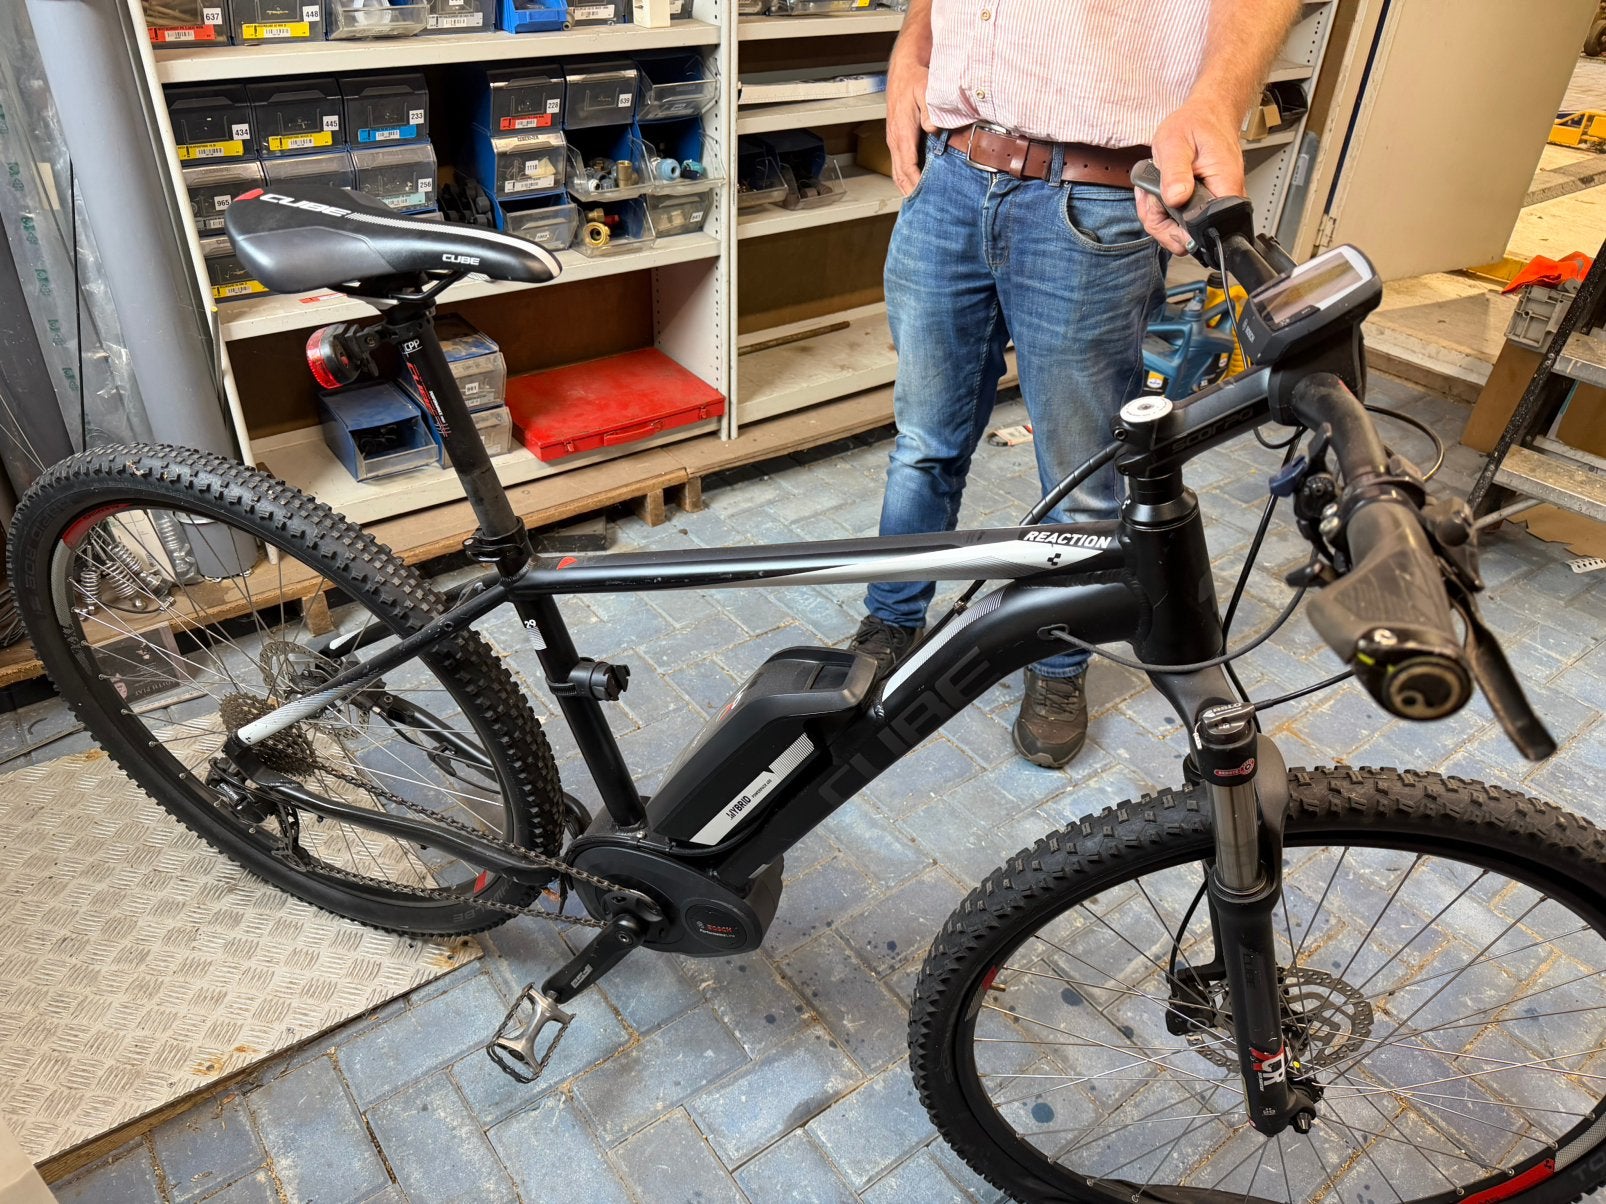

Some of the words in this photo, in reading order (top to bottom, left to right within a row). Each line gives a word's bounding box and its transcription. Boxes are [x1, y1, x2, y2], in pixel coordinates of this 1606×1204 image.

[205, 12, 220, 21] 637
[305, 10, 319, 18] 448
[410, 112, 423, 120] 233
[234, 128, 249, 136] 434
[419, 180, 432, 188] 256
[260, 193, 353, 218] CUBE
[442, 253, 480, 265] CUBE
[1023, 530, 1113, 549] REACTION
[524, 619, 537, 629] 29
[725, 794, 752, 820] HYBRID
